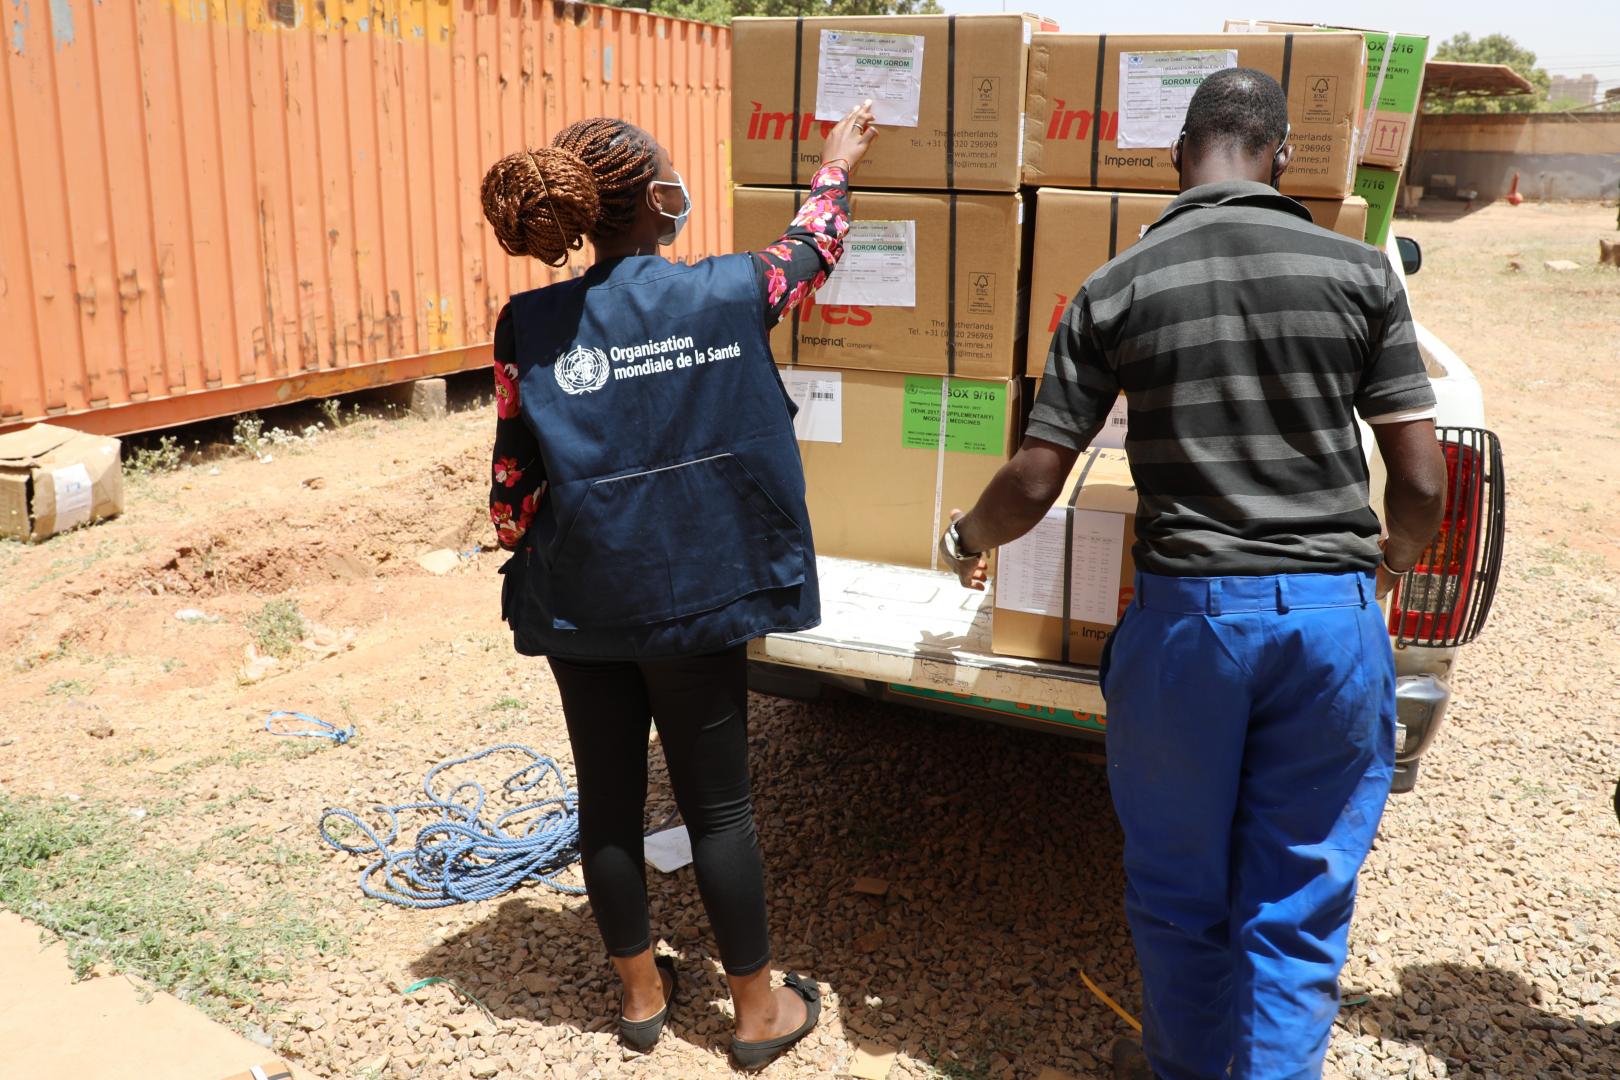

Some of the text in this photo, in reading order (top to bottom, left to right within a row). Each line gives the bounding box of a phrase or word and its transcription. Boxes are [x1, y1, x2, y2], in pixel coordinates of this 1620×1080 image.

[883, 59, 910, 67] GOROM
[1162, 78, 1191, 86] GOROM
[970, 141, 998, 149] 296969
[1300, 144, 1331, 152] 296969
[1104, 155, 1153, 168] Imperial
[1361, 179, 1385, 190] 7/16
[967, 331, 993, 340] 296969
[801, 335, 845, 348] Imperial
[610, 335, 694, 363] Organisation
[614, 342, 741, 380] mondiale de la Santé
[973, 391, 996, 401] 9/16
